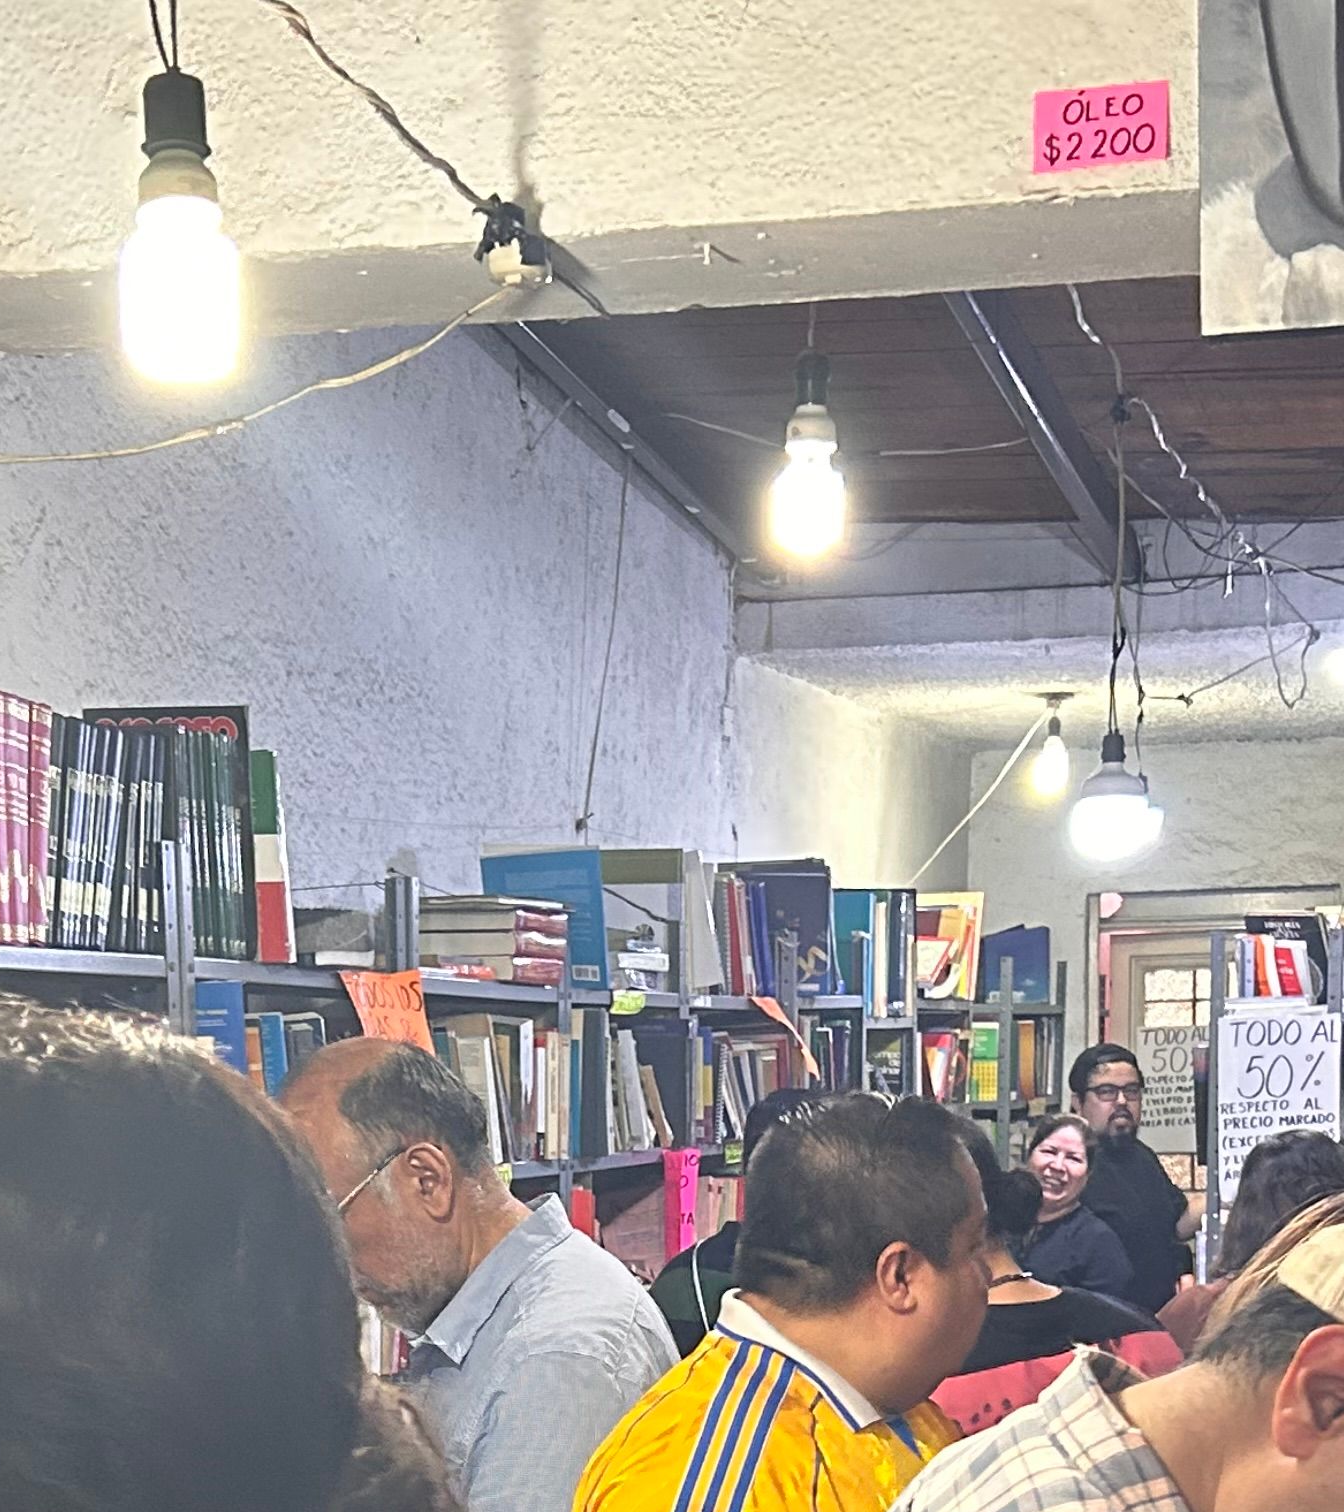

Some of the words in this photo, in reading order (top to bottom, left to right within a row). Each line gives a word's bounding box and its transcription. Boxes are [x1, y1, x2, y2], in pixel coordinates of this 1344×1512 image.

[1062, 90, 1144, 125] ÓLEO
[1141, 1027, 1187, 1046] TODO
[1230, 1019, 1302, 1047] TODO
[1311, 1019, 1339, 1043] AL
[1151, 1047, 1194, 1073] 50
[1237, 1051, 1325, 1099] 50%
[1220, 1100, 1290, 1115] RESPECTO
[1303, 1098, 1323, 1110] AL
[1224, 1114, 1274, 1130] PRECIO
[1279, 1113, 1336, 1126] MARCADO
